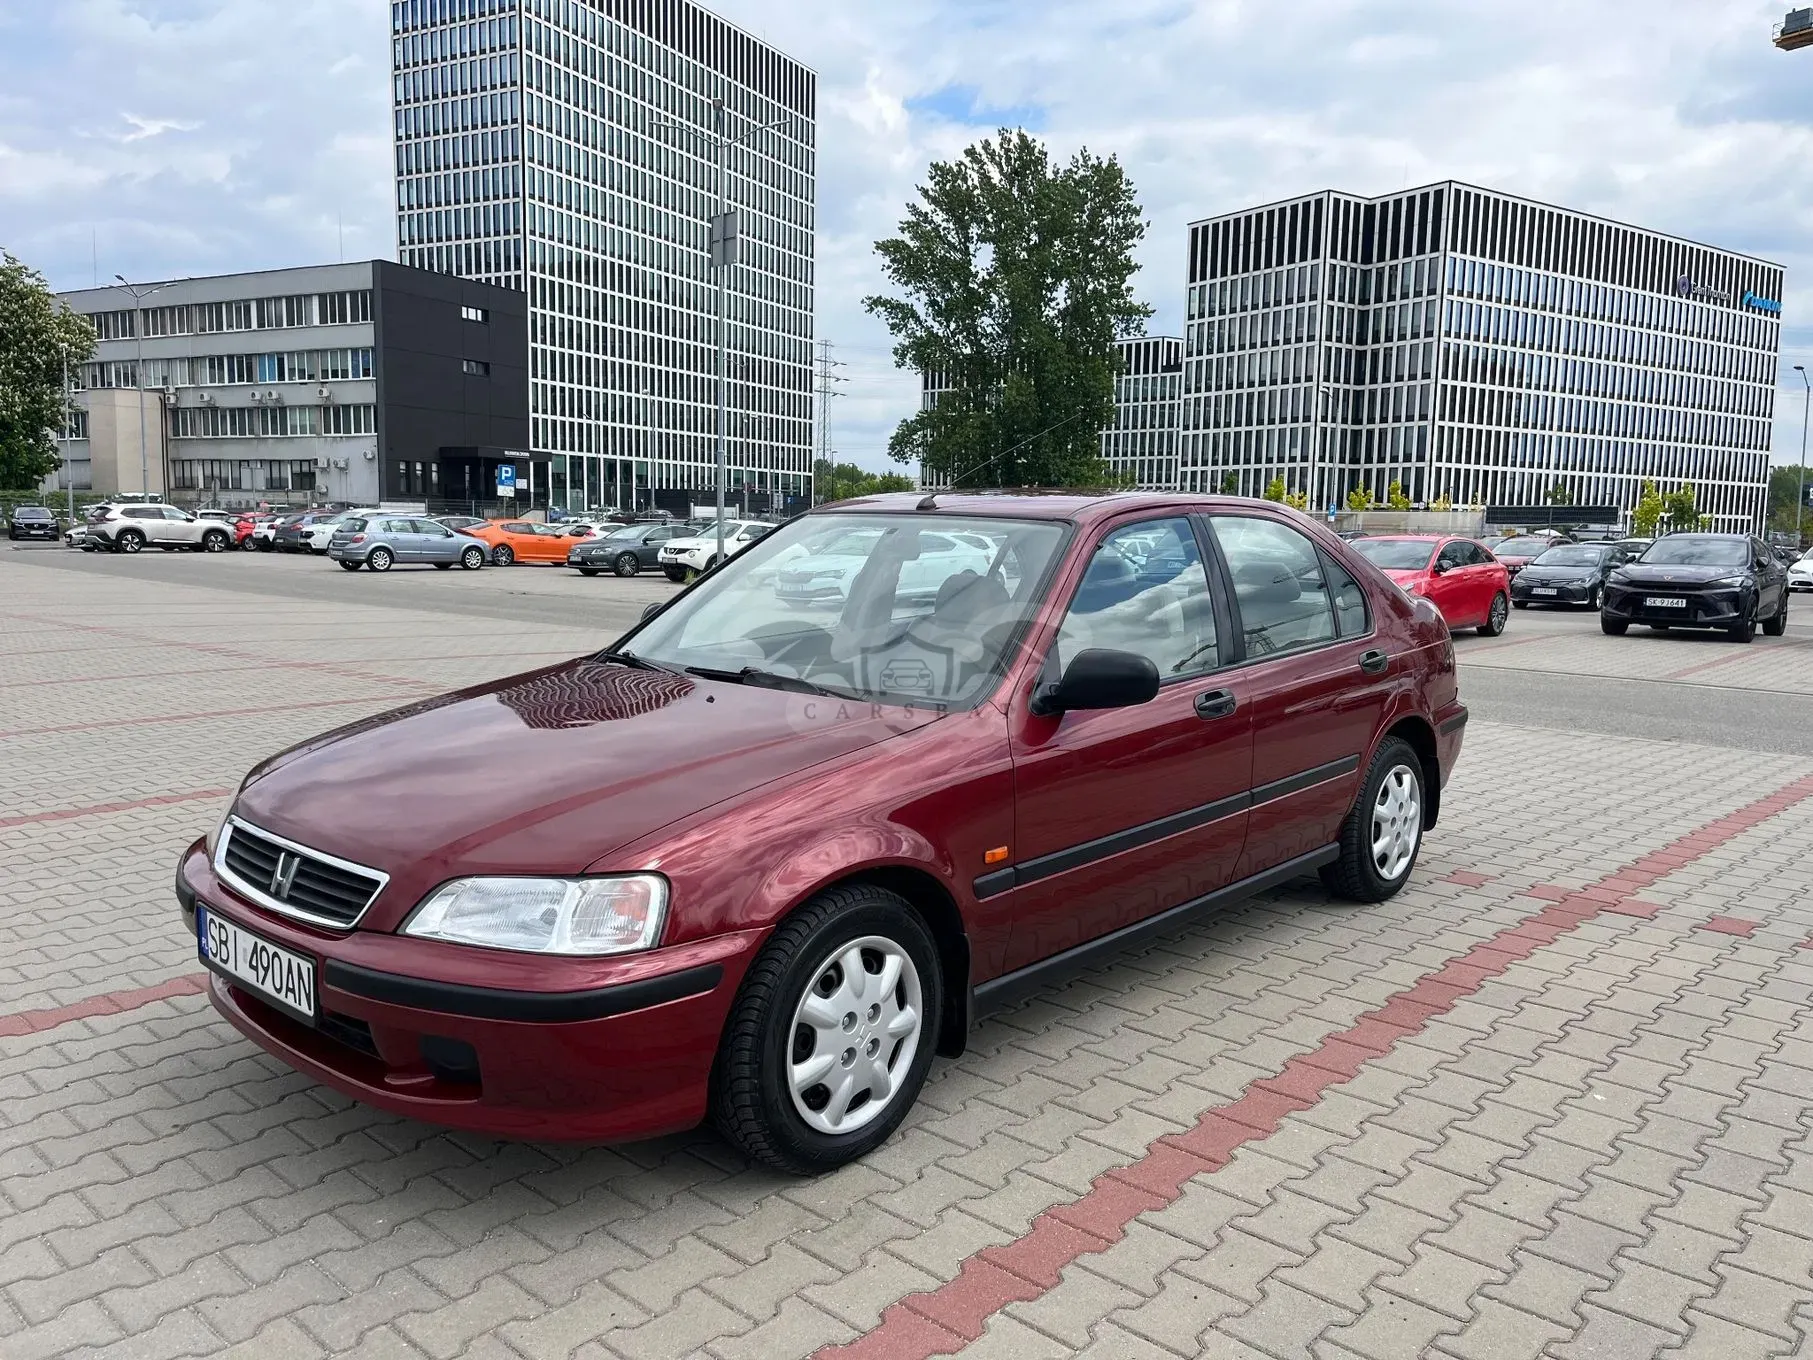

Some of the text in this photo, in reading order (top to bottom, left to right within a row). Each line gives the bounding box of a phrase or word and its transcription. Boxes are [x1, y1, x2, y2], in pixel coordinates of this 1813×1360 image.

[1751, 296, 1782, 311] DAIKIN
[501, 466, 512, 480] P
[209, 918, 311, 1011] SBI 490AN
